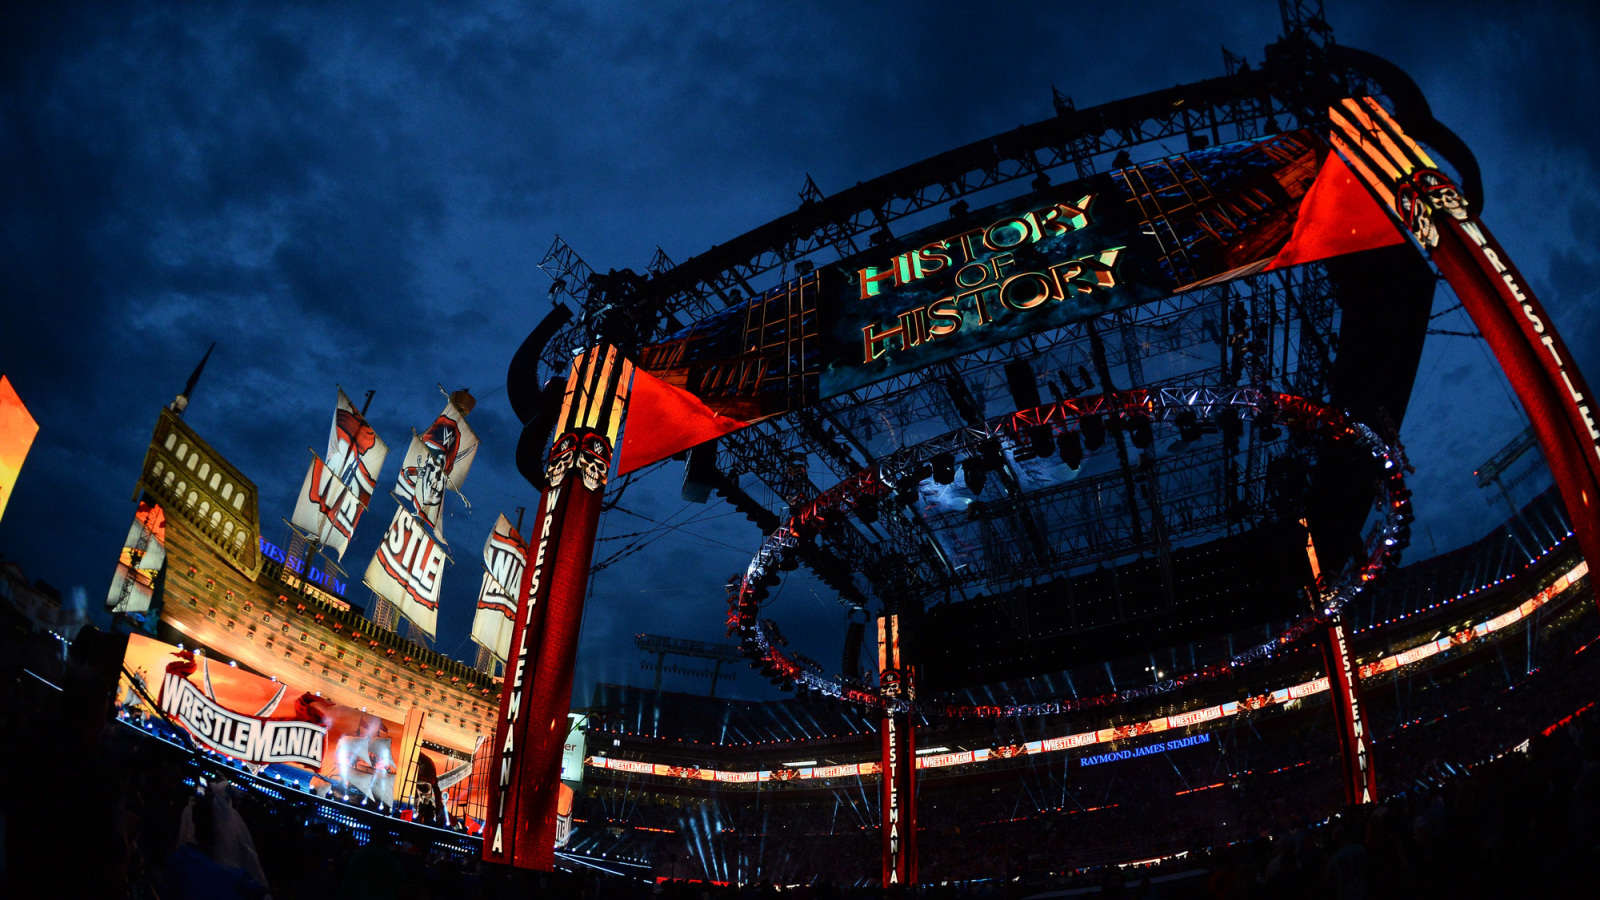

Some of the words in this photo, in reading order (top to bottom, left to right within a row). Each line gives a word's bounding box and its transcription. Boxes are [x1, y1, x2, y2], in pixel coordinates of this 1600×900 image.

[859, 193, 1098, 299] HISTORY
[955, 254, 1016, 288] OF
[862, 246, 1126, 363] HISTORY
[1460, 221, 1600, 460] WRESTLE
[389, 514, 441, 592] STLE
[286, 555, 346, 596] STDIUM
[491, 488, 562, 853] WRESTLEMANIA
[162, 673, 324, 763] WRESTLEMANIA
[1168, 706, 1221, 728] WRESTLEMANIA
[922, 751, 972, 768] WRESTLEMANIA
[1043, 731, 1096, 751] WRESTLEMANIA
[1080, 750, 1132, 767] RAYMOND
[1132, 743, 1165, 758] JAMES
[1167, 733, 1210, 750] STADIUM
[608, 758, 653, 774] WRESTLEMANIA
[813, 764, 858, 778] WRESTLEMANIA
